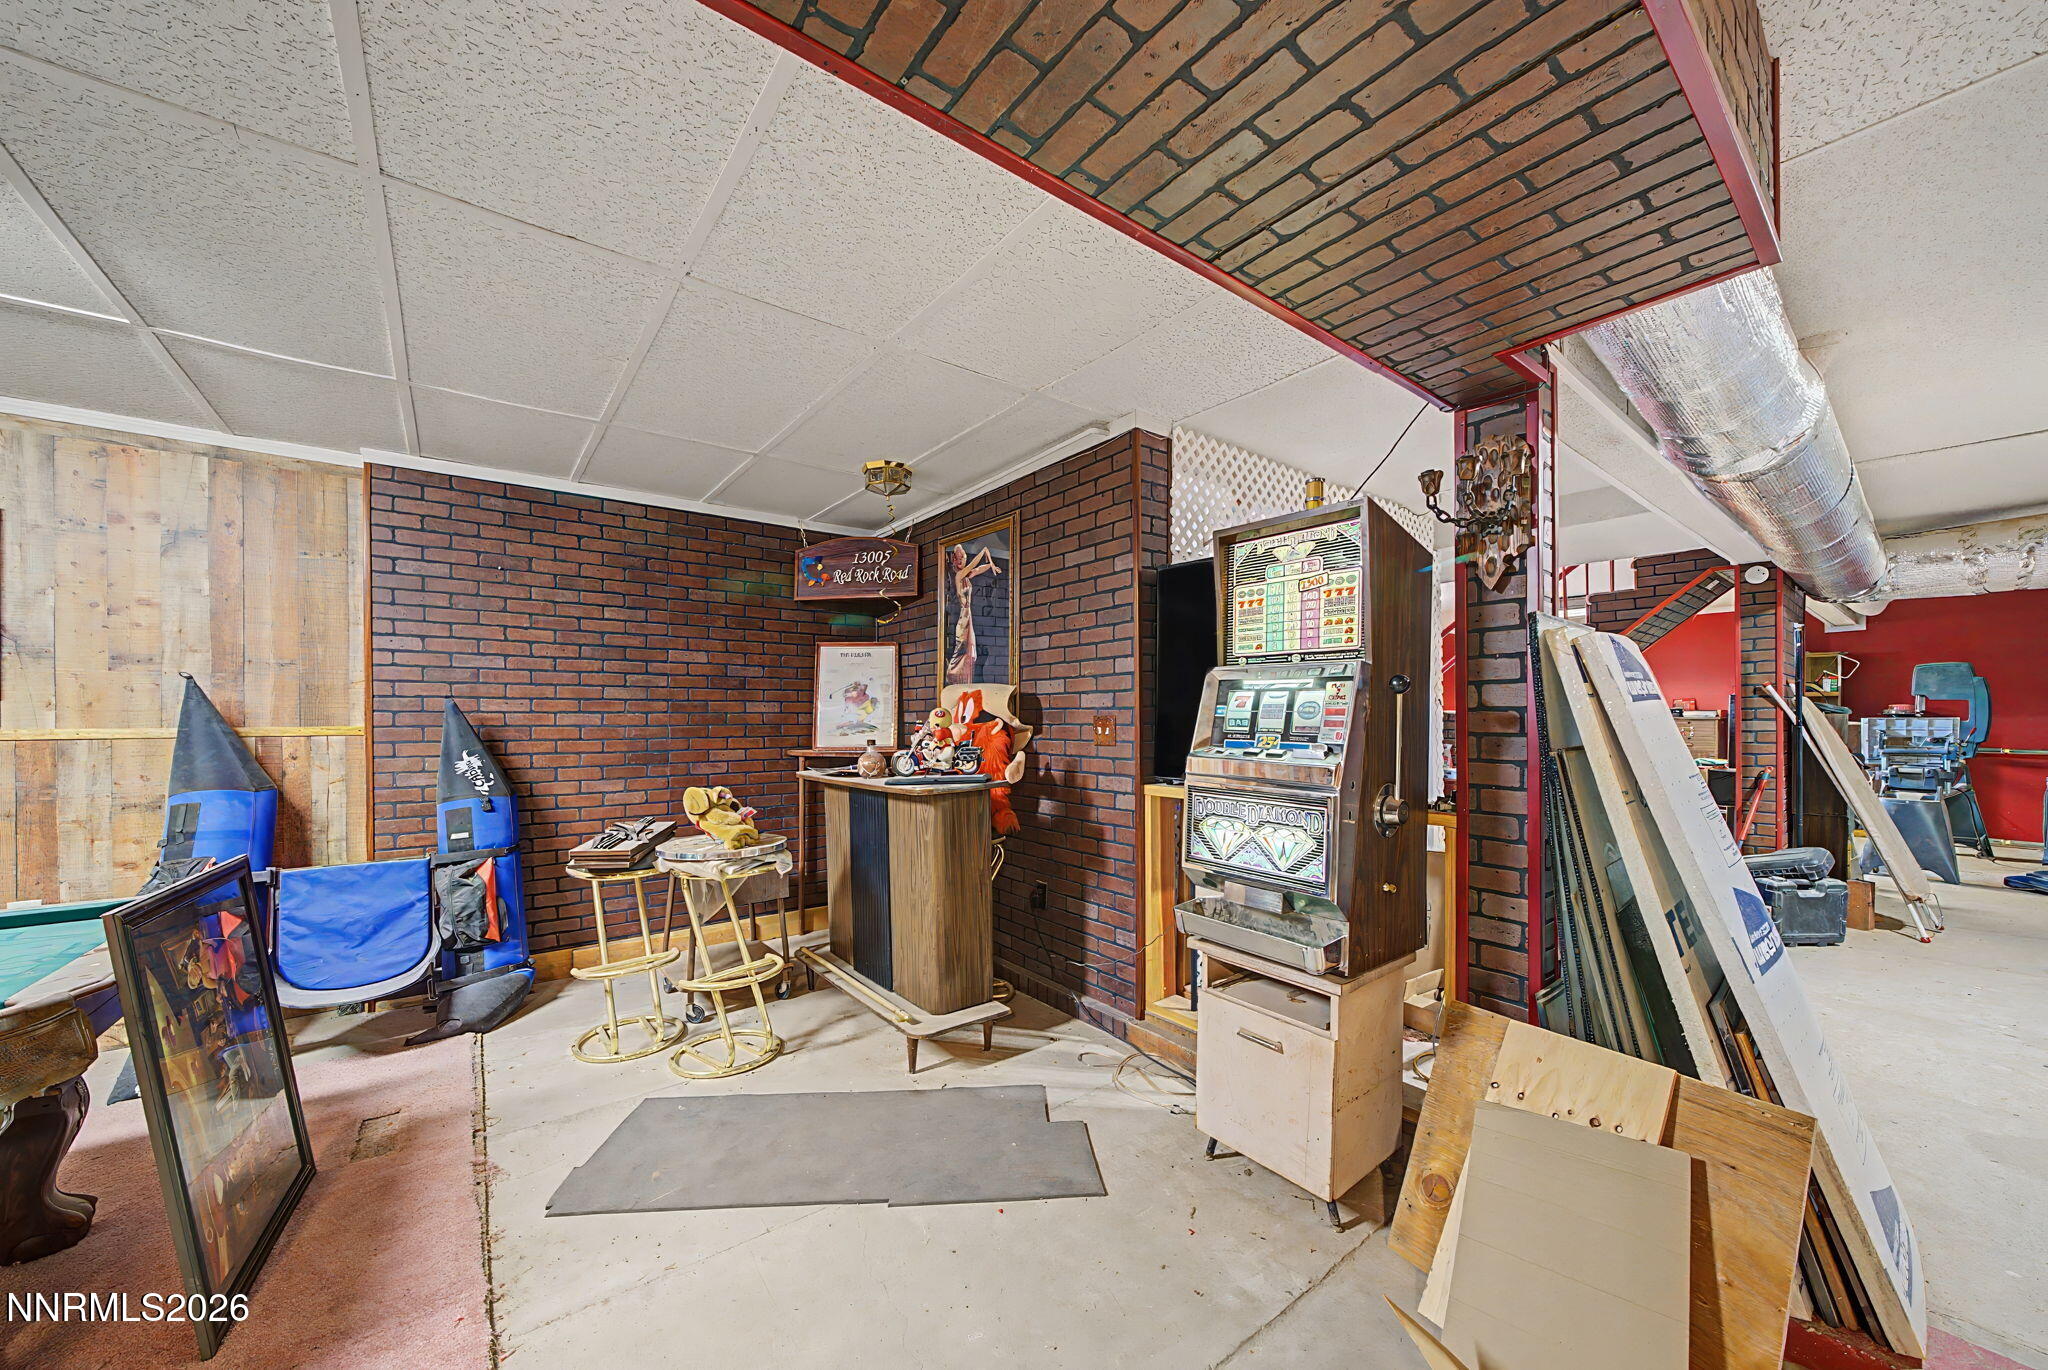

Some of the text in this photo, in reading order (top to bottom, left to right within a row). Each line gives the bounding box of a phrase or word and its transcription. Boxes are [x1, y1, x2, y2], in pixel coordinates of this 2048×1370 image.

[852, 550, 892, 566] 13005
[833, 564, 912, 584] Red Rock Road
[1235, 696, 1251, 708] 7
[1228, 719, 1249, 727] BAR
[1194, 795, 1325, 836] DOUBLE DIAMOND
